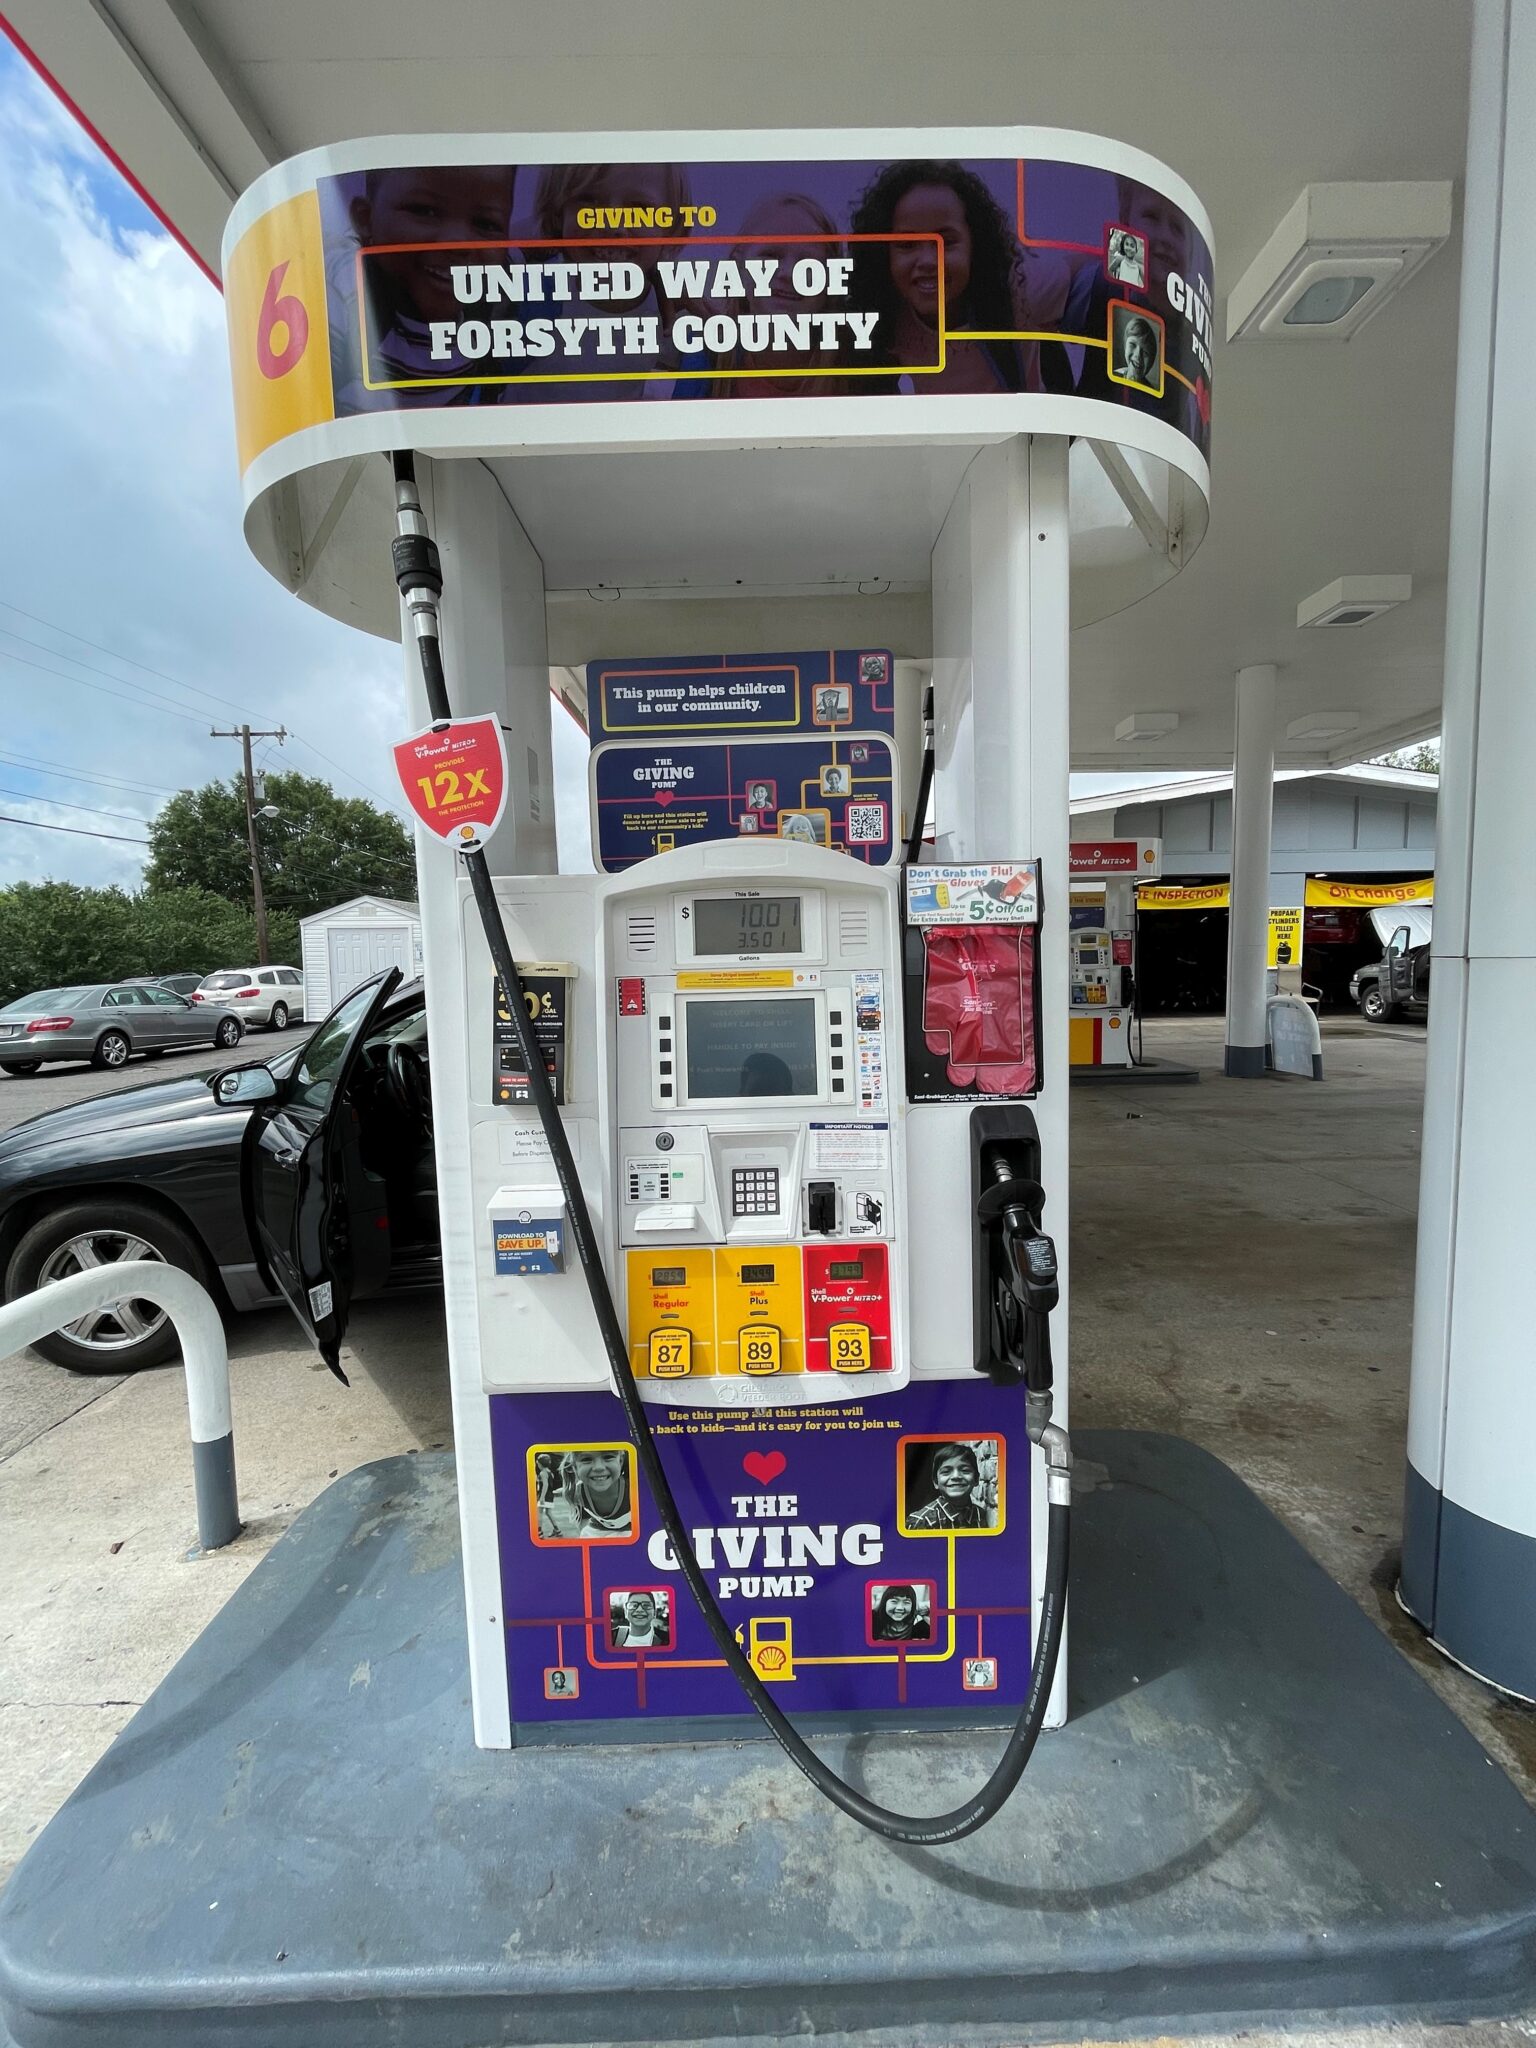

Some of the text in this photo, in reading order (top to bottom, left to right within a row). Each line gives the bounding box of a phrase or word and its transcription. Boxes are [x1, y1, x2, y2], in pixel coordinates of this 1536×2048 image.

[577, 205, 716, 229] GIVING TO
[450, 258, 854, 304] UNITED WAY OF
[256, 260, 310, 380] 6
[429, 312, 879, 360] FORSYTH COUNTY
[613, 683, 786, 700] This pump helps children
[638, 698, 762, 713] in our community.
[416, 746, 449, 759] V-Power
[434, 756, 465, 770] PROVIDES
[654, 758, 672, 766] THE
[633, 766, 695, 781] GIVING
[651, 781, 677, 789] PUMP
[438, 800, 485, 817] THE PROTECTION
[1101, 857, 1131, 865] NITRO+
[909, 865, 1013, 878] Don't Grab the Flu!
[950, 878, 985, 887] Gloves
[1153, 888, 1224, 900] INSPECTION
[1329, 885, 1416, 900] Oil Change
[681, 902, 798, 928] $ 10.01
[738, 931, 785, 948] 3.501
[498, 1239, 544, 1249] SAVE UP.
[653, 1299, 689, 1310] Regular
[749, 1297, 769, 1305] Plus
[811, 1294, 851, 1303] V-Power
[657, 1345, 683, 1363] 87
[747, 1341, 773, 1360] 89
[837, 1339, 863, 1357] 93
[668, 1411, 690, 1421] Use
[691, 1411, 714, 1420] this
[716, 1411, 749, 1422] pump
[775, 1408, 797, 1418] this
[799, 1408, 839, 1417] station
[842, 1407, 864, 1416] will
[657, 1424, 684, 1434] back
[686, 1424, 698, 1433] to
[758, 1421, 774, 1431] it's
[777, 1421, 802, 1433] easy
[805, 1420, 821, 1430] for
[824, 1421, 846, 1432] you
[848, 1421, 860, 1429] to
[862, 1419, 884, 1430] join
[886, 1420, 903, 1429] us.
[731, 1495, 798, 1518] THE
[647, 1523, 884, 1571] GIVING
[718, 1575, 815, 1599] PUMP
